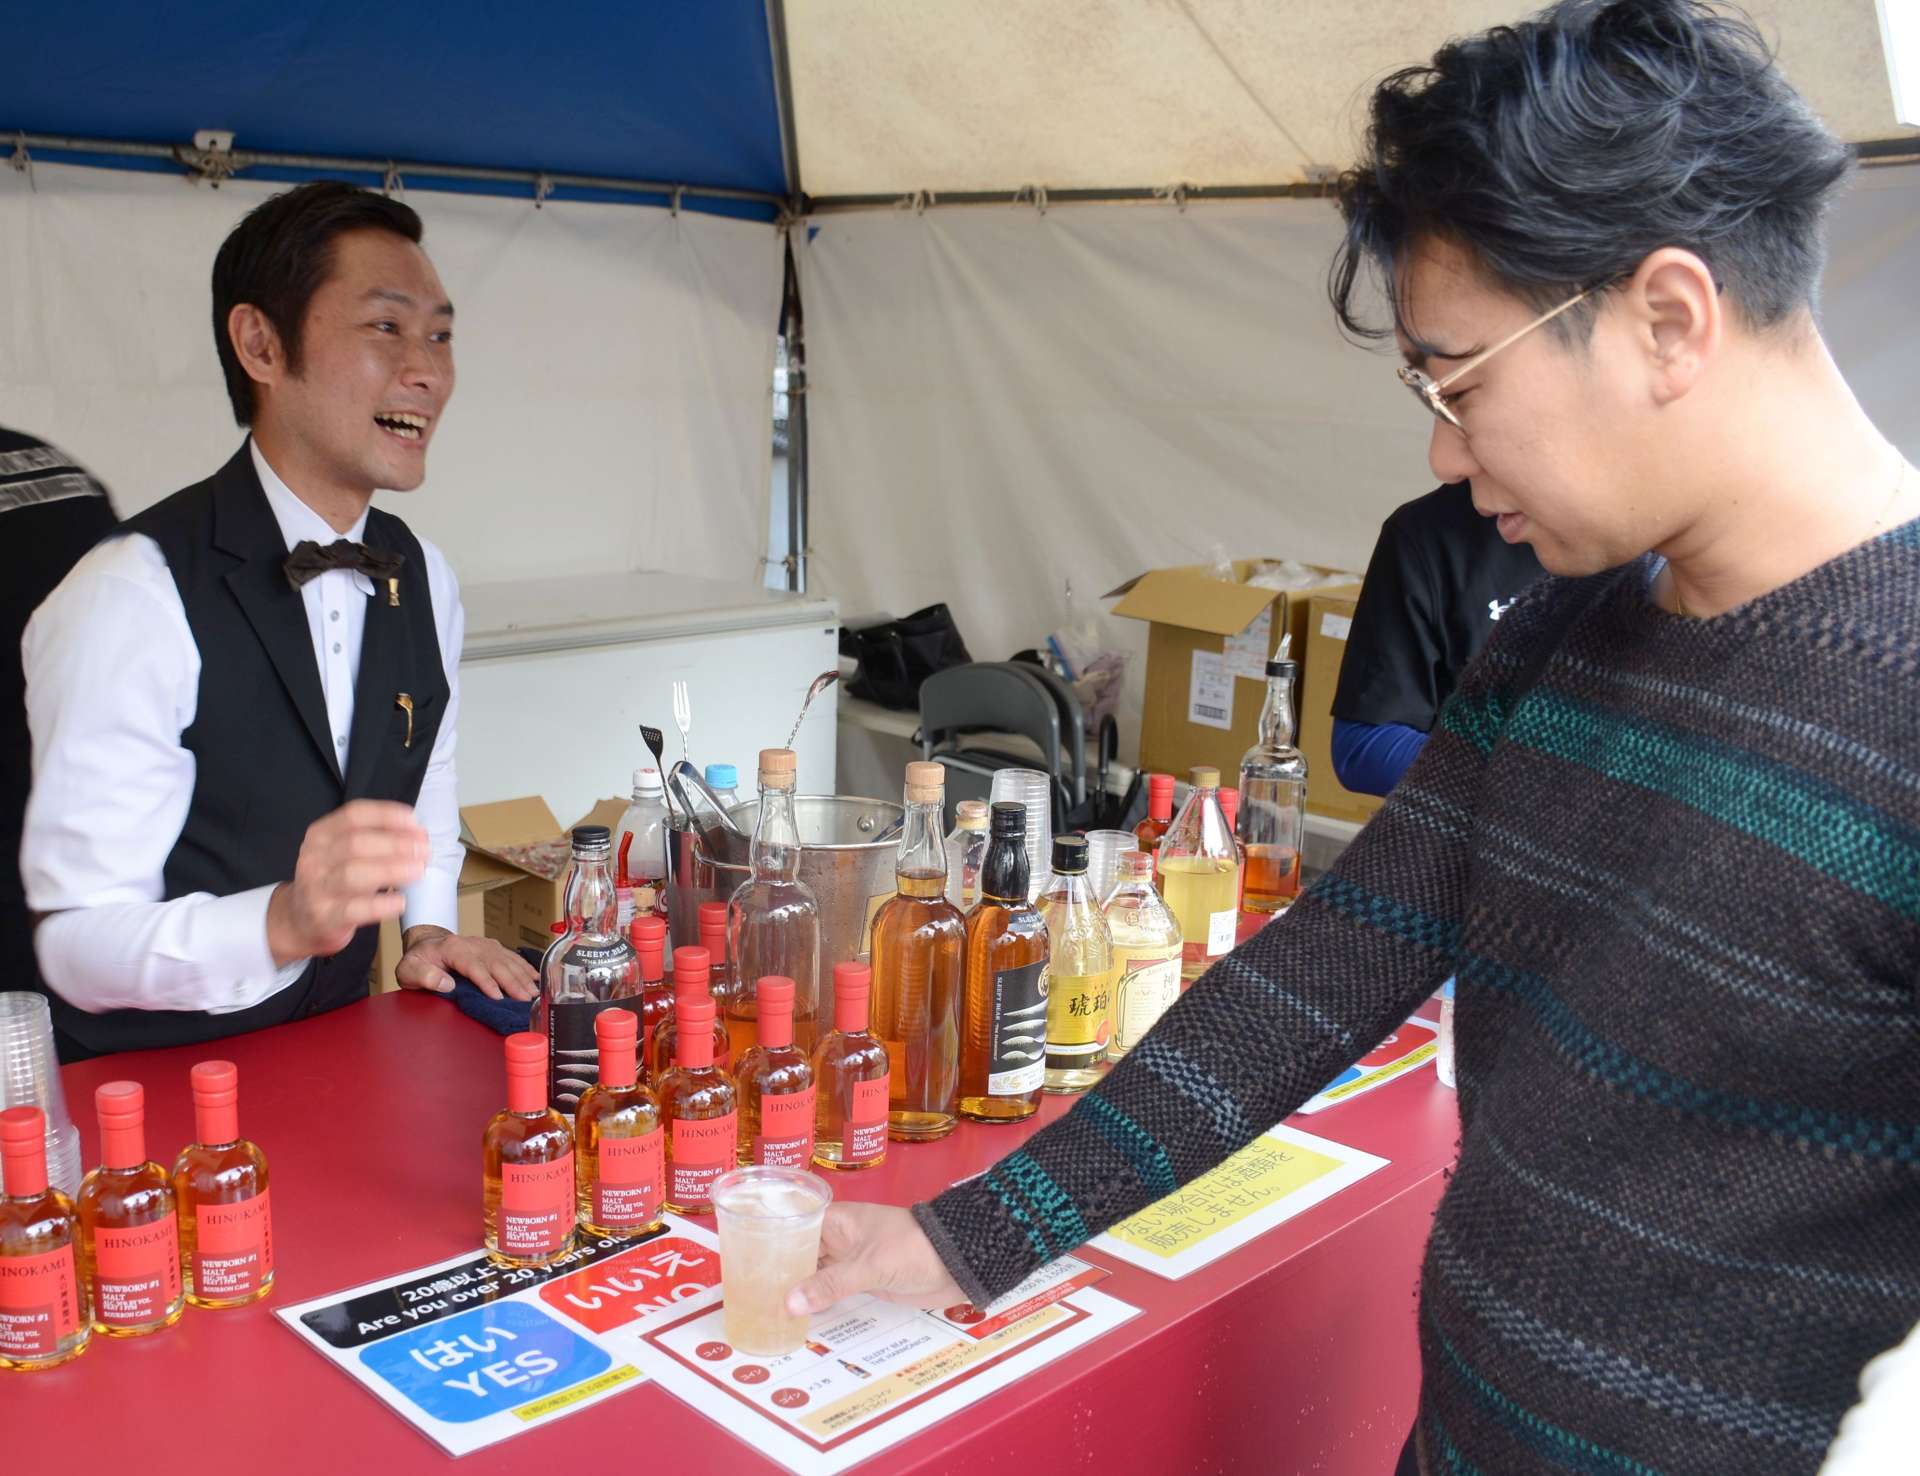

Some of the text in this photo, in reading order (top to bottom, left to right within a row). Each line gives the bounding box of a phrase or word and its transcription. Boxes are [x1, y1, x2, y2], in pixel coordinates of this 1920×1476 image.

[575, 949, 610, 958] SLEEPY
[681, 1120, 735, 1138] HINOKAMI
[853, 1126, 884, 1136] NEWBORN
[763, 1140, 800, 1150] NEWBORN
[764, 1150, 784, 1158] MALT
[511, 1164, 570, 1184] HINOKAMI
[674, 1167, 722, 1178] NEWBORN #1
[674, 1177, 696, 1185] MALT
[602, 1185, 651, 1198] NEWBORN #1
[674, 1191, 701, 1200] BOURBON
[1119, 1151, 1295, 1237] ない場合には酒類を
[602, 1197, 623, 1205] MALT
[206, 1199, 268, 1225] HINOKAMI
[602, 1211, 630, 1220] BOURBON
[1143, 1185, 1281, 1250] 販売しません。
[505, 1212, 558, 1226] NEWBORN #1
[505, 1224, 528, 1233] MALT
[104, 1224, 173, 1249] HINOKAMI
[506, 1240, 535, 1249] BOURBON
[0, 1256, 66, 1278] INOKAMI
[202, 1253, 258, 1269] NEWBORN #1
[202, 1268, 226, 1277] MALT
[102, 1279, 160, 1293] NEWBORN #1
[563, 1249, 706, 1310] いいえ
[203, 1285, 234, 1294] BOURBON
[103, 1292, 126, 1301] MALT
[357, 1314, 401, 1336] Are
[402, 1299, 449, 1320] you
[452, 1280, 500, 1303] over
[503, 1267, 534, 1285] 20
[37, 1312, 49, 1322] #1
[103, 1310, 135, 1319] BOURBON
[409, 1326, 518, 1373] はい
[703, 1344, 725, 1358] コイン
[444, 1348, 560, 1398] YES
[740, 1367, 763, 1382] コイン
